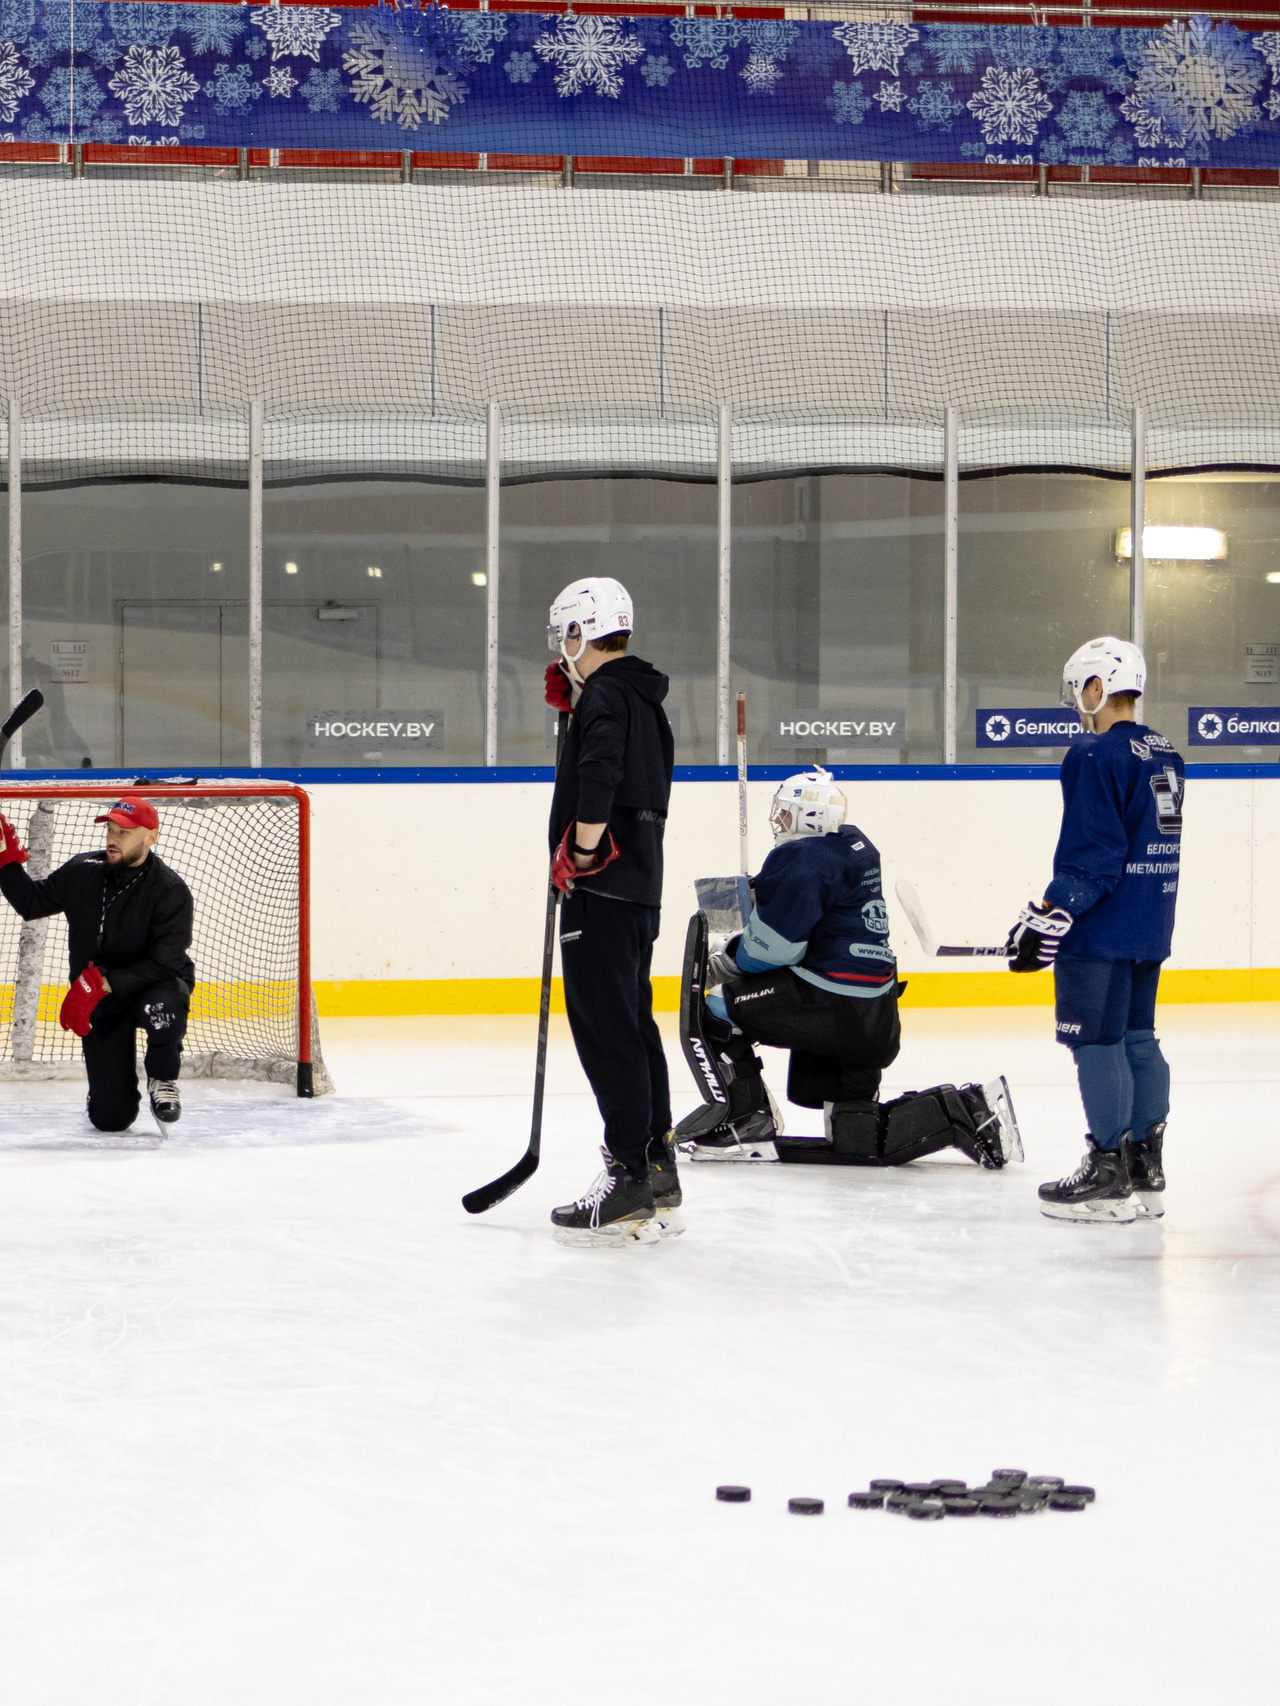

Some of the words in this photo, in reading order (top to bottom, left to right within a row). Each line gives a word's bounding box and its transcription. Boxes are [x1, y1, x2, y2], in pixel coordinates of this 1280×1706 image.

[617, 615, 629, 627] 83
[314, 722, 435, 737] HOCKEY.BY
[780, 721, 897, 736] HOCKEY.BY
[1226, 717, 1280, 733] белка
[973, 946, 1008, 957] CCM
